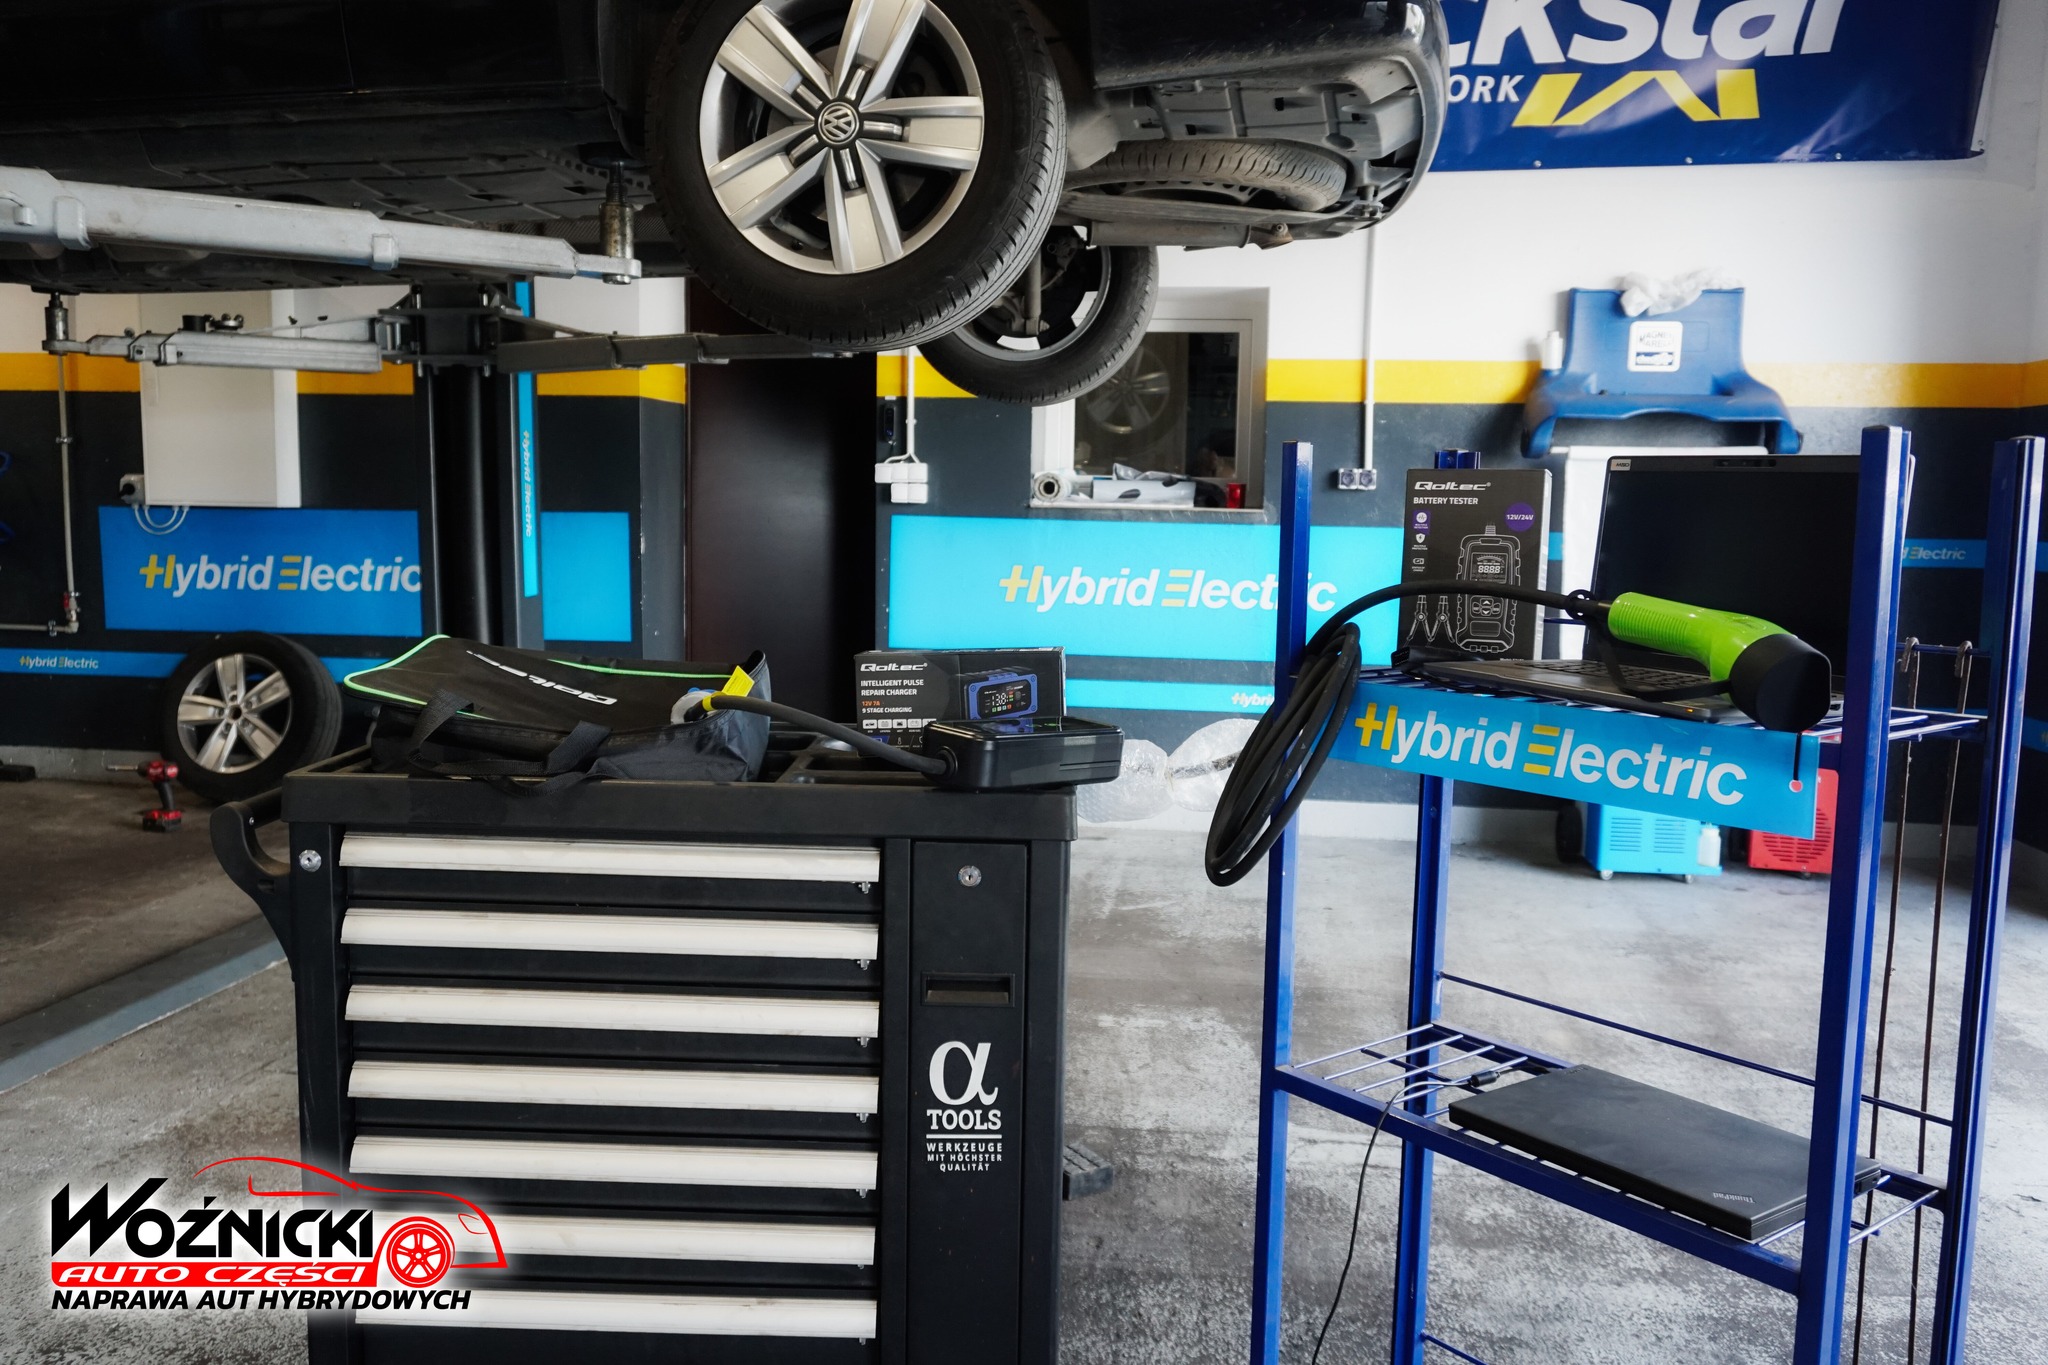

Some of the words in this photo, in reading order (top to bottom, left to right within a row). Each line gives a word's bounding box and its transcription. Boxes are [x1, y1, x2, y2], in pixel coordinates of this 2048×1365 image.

[1413, 496, 1447, 505] BATTERY
[1449, 497, 1479, 505] TESTER
[1908, 546, 1967, 560] Electric
[139, 554, 274, 598] Hybrid
[277, 555, 422, 592] Electric
[999, 565, 1160, 613] Hybrid
[1161, 569, 1338, 612] Electc
[20, 655, 57, 669] Hybrid
[58, 656, 99, 669] Electric
[860, 679, 902, 687] INTELLIGENT
[886, 688, 918, 696] CHARGER
[1355, 702, 1522, 770] Hybrid
[1523, 724, 1748, 805] Electric
[926, 1109, 1001, 1130] TOOLS
[926, 1142, 1002, 1152] WERKZEUGE
[927, 1153, 945, 1161] MIT
[950, 1152, 1002, 1161] HÖCHSTER
[940, 1162, 990, 1172] QUALITÄT
[1712, 1192, 1755, 1204] ThinkPad
